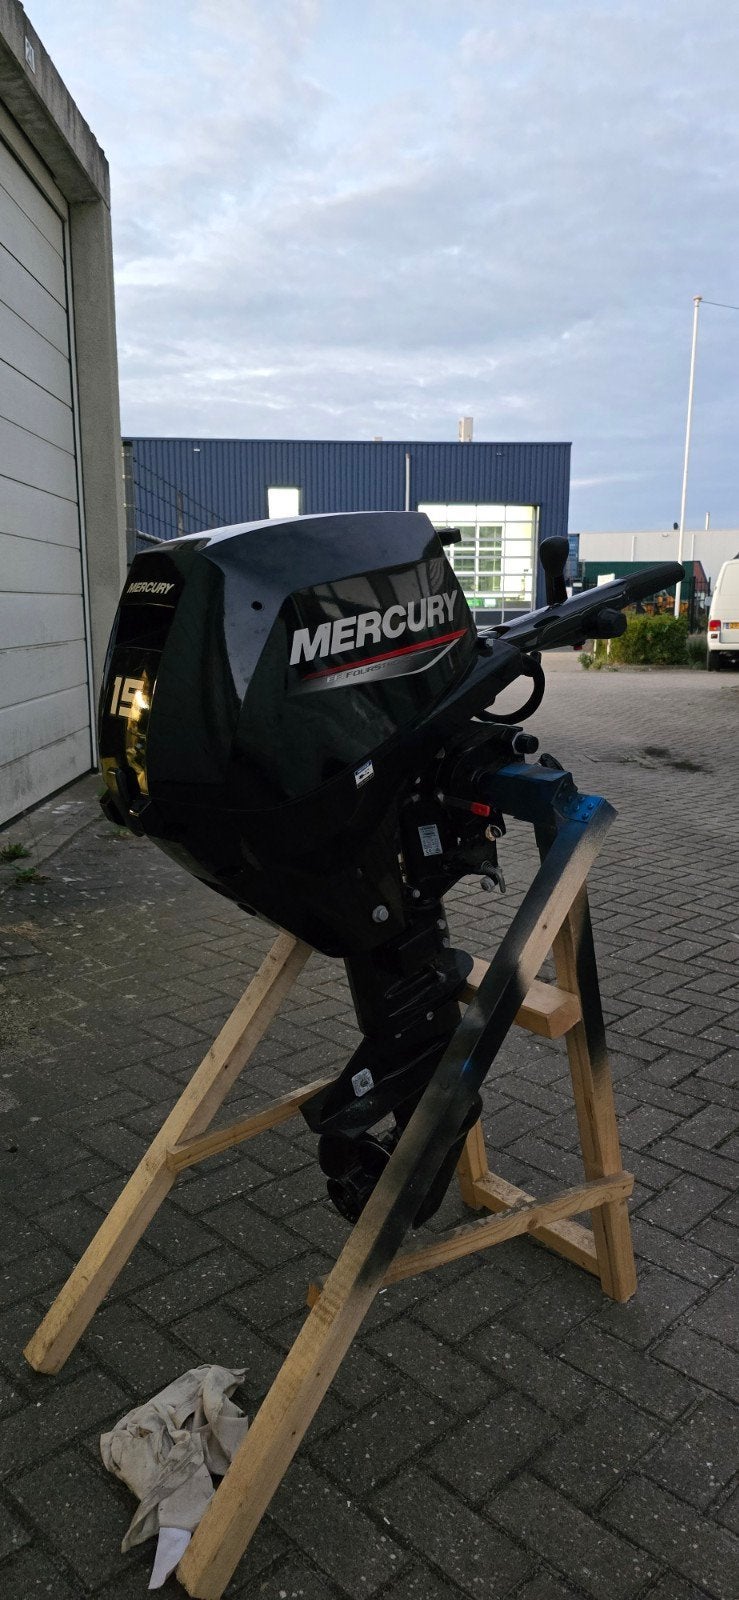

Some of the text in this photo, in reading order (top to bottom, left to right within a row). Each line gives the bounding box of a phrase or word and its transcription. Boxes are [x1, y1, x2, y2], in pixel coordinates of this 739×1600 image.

[126, 582, 175, 595] MERCURY
[289, 590, 458, 666] MERCURY
[109, 676, 144, 722] 15
